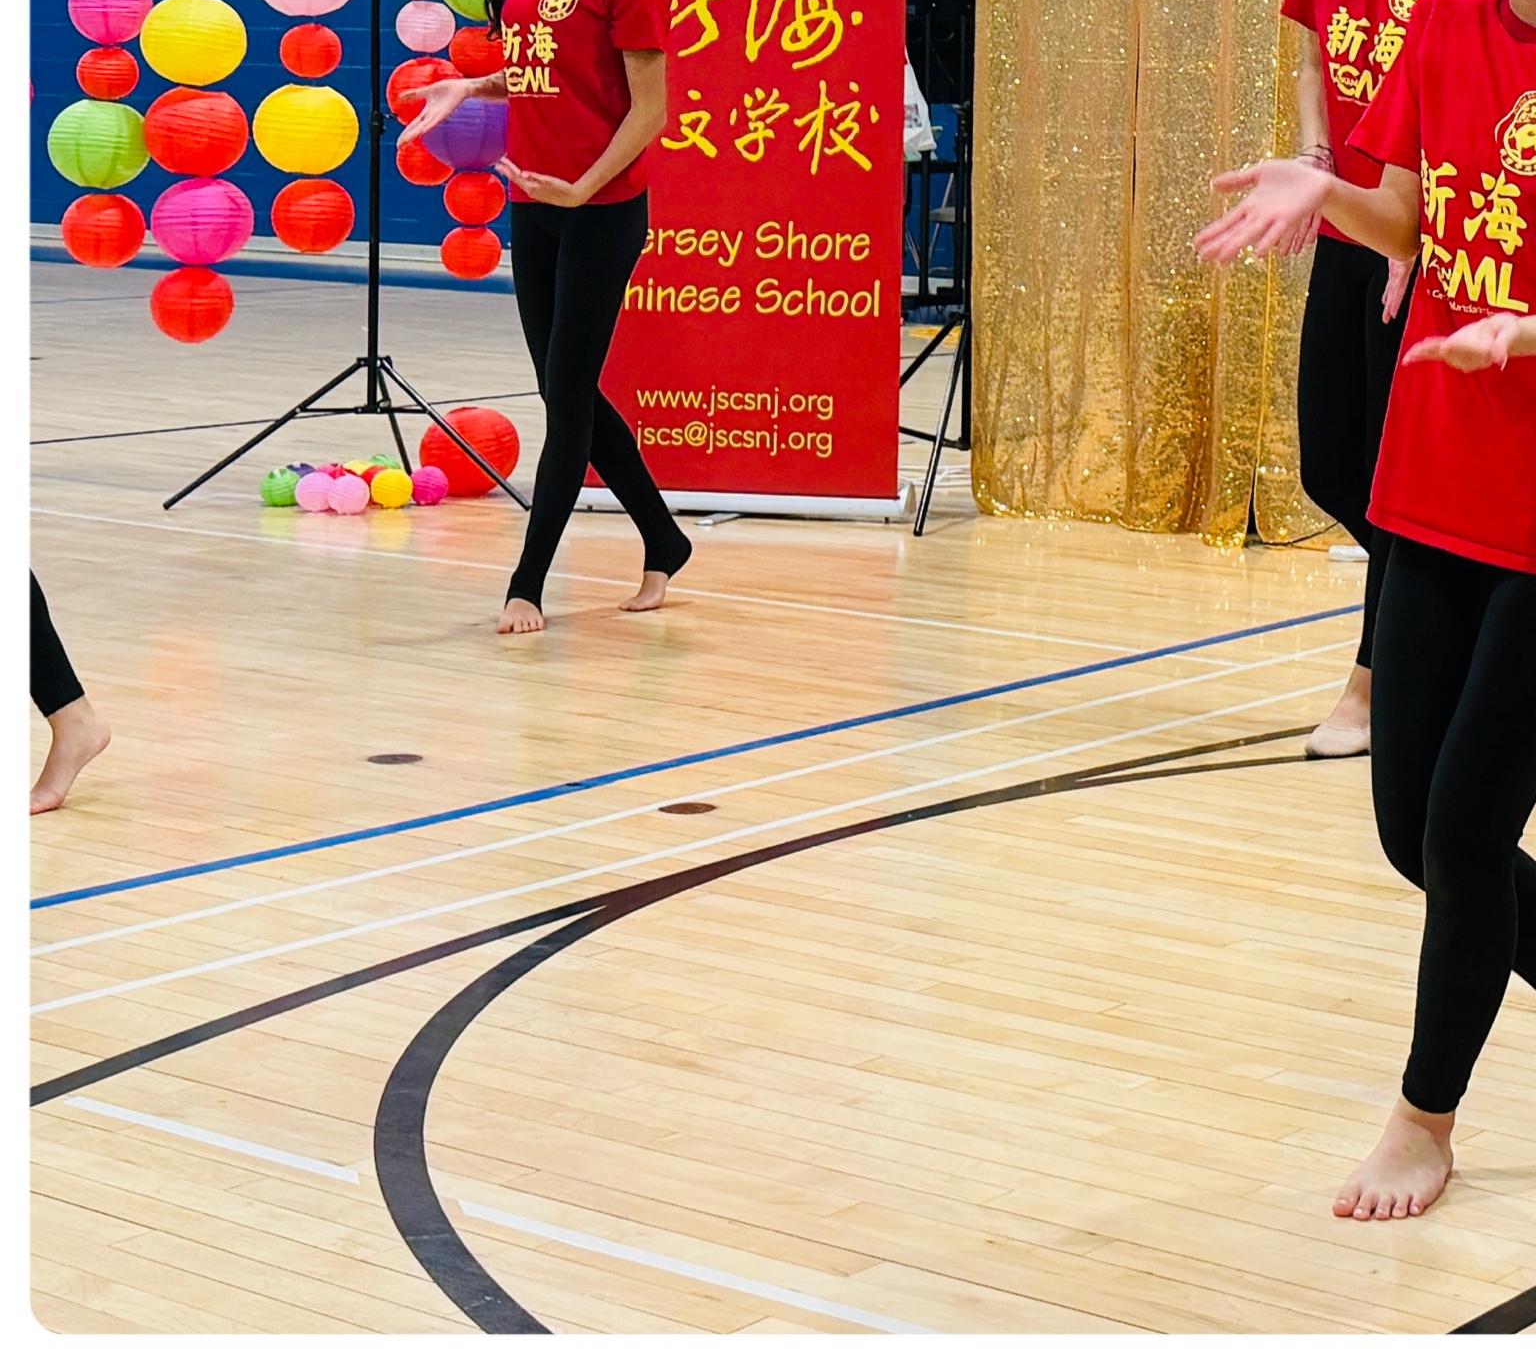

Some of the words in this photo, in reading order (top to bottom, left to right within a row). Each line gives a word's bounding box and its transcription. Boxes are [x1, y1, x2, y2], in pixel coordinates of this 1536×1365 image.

[1325, 5, 1407, 73] 新海
[503, 65, 560, 94] CML
[1328, 61, 1386, 103] TCM
[660, 80, 880, 176] 文学校
[641, 227, 743, 267] ersey
[755, 221, 871, 262] Shore
[624, 277, 741, 314] hinese
[755, 278, 881, 318] School
[636, 384, 834, 421] www.jscsnj.org
[636, 420, 834, 458] jscs@jscsnj.org
